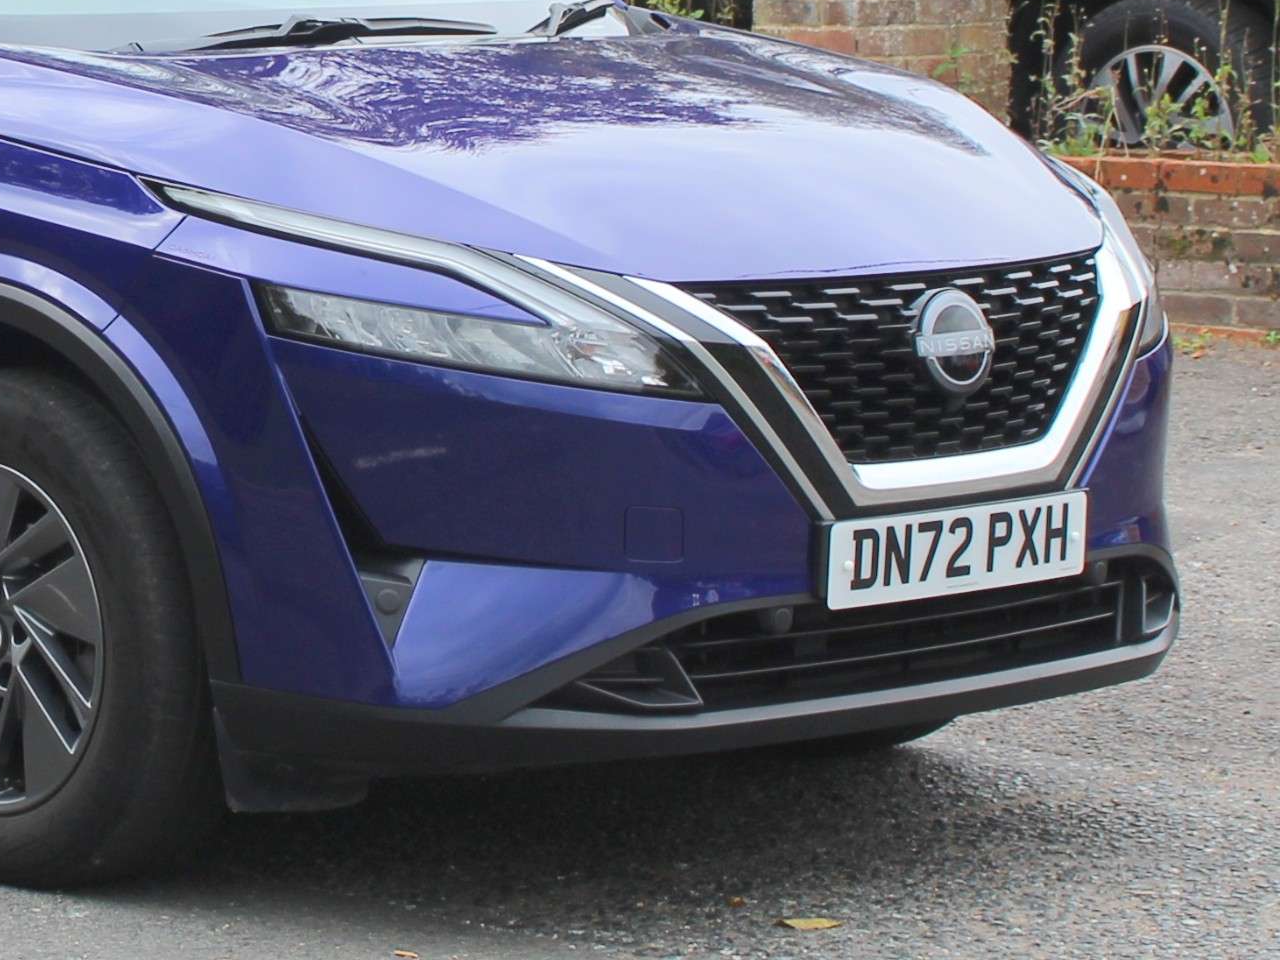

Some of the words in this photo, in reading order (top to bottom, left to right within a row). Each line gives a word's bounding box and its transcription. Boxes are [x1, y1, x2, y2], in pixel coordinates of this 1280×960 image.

[919, 334, 994, 353] NISSAN
[850, 517, 973, 590] DN72
[986, 503, 1069, 572] PXH
